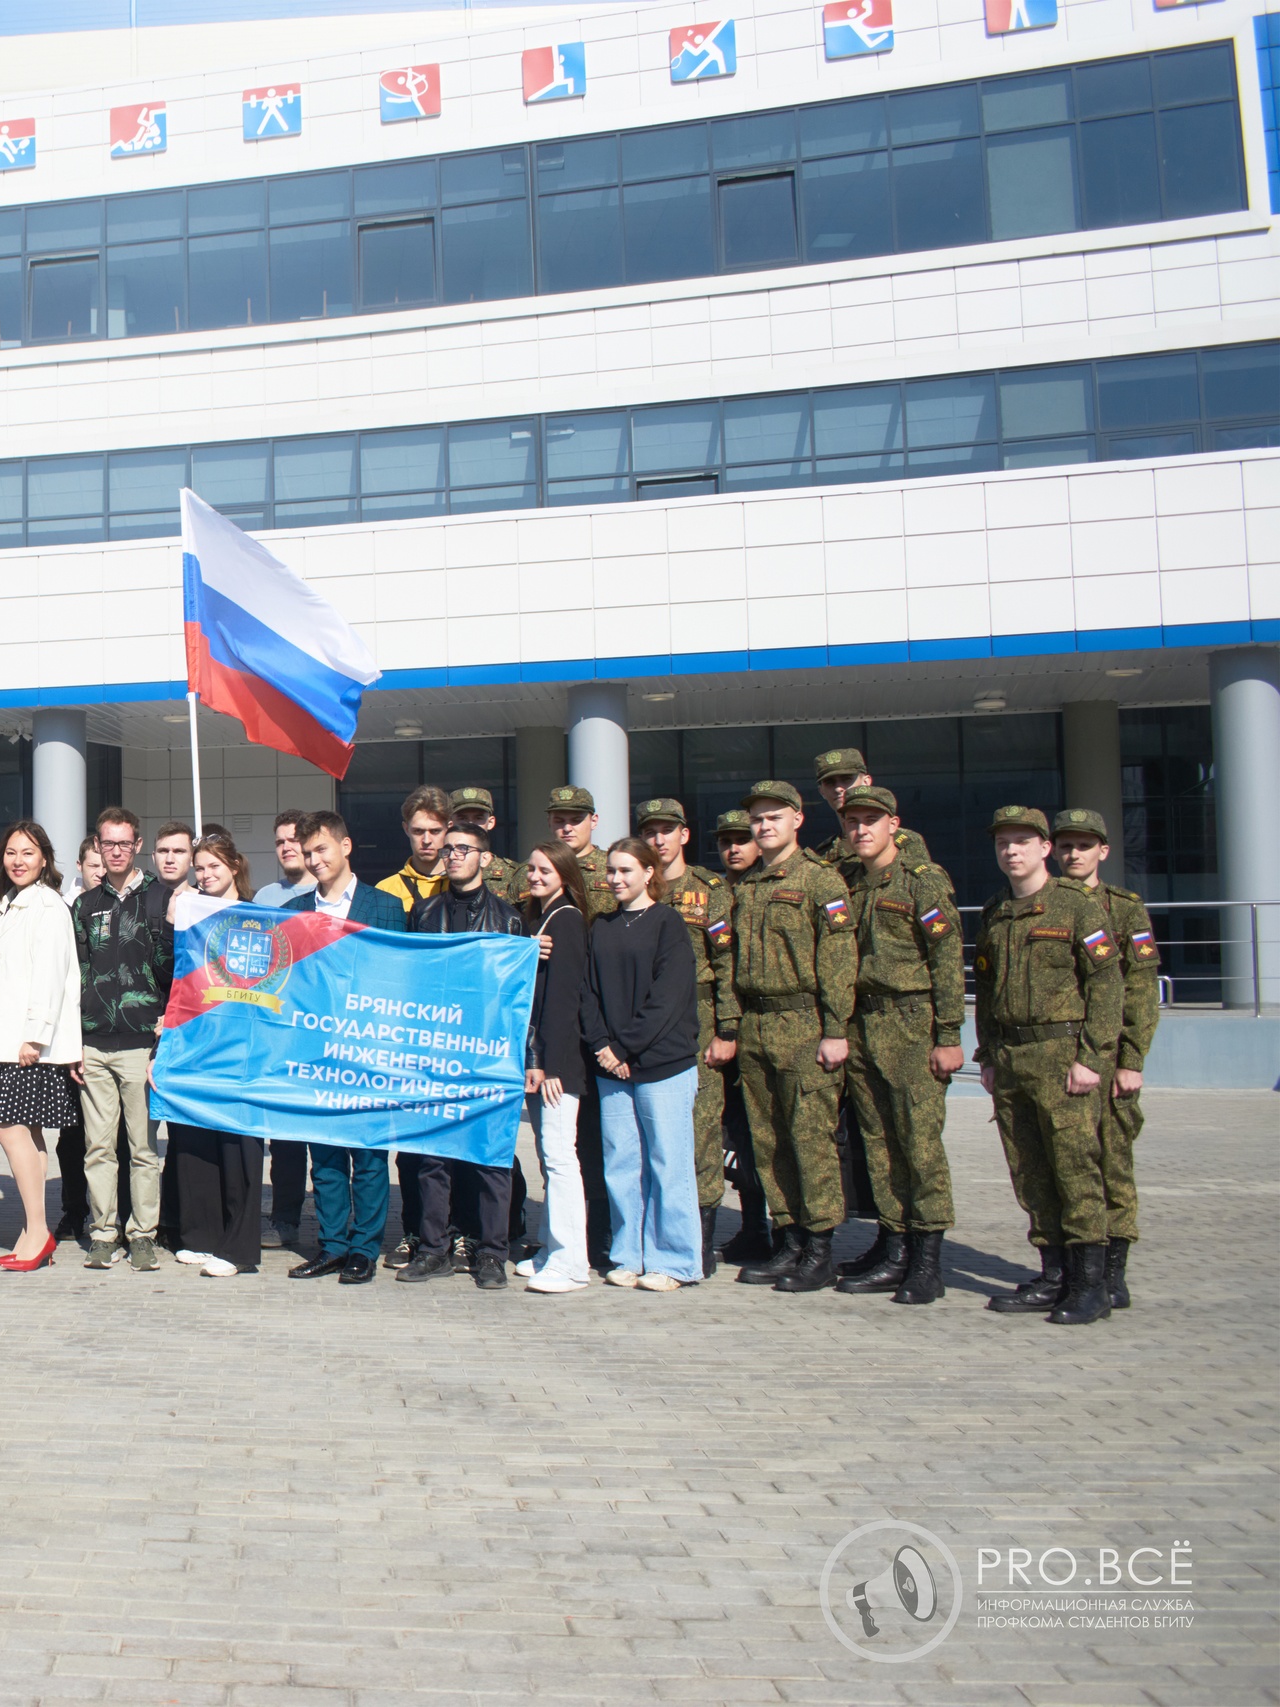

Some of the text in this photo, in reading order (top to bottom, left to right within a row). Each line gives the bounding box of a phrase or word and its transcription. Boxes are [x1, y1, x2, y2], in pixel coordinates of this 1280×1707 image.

[226, 989, 262, 1003] БГИТУ
[345, 992, 464, 1025] БРЯНСКИЙ
[291, 1010, 510, 1058] ГОСУДАРСТВЕННЫЙ
[322, 1041, 470, 1077] ИНЖЕНЕРНО-
[285, 1060, 506, 1103] ТЕХНОЛОГИЧЕСКИЙ
